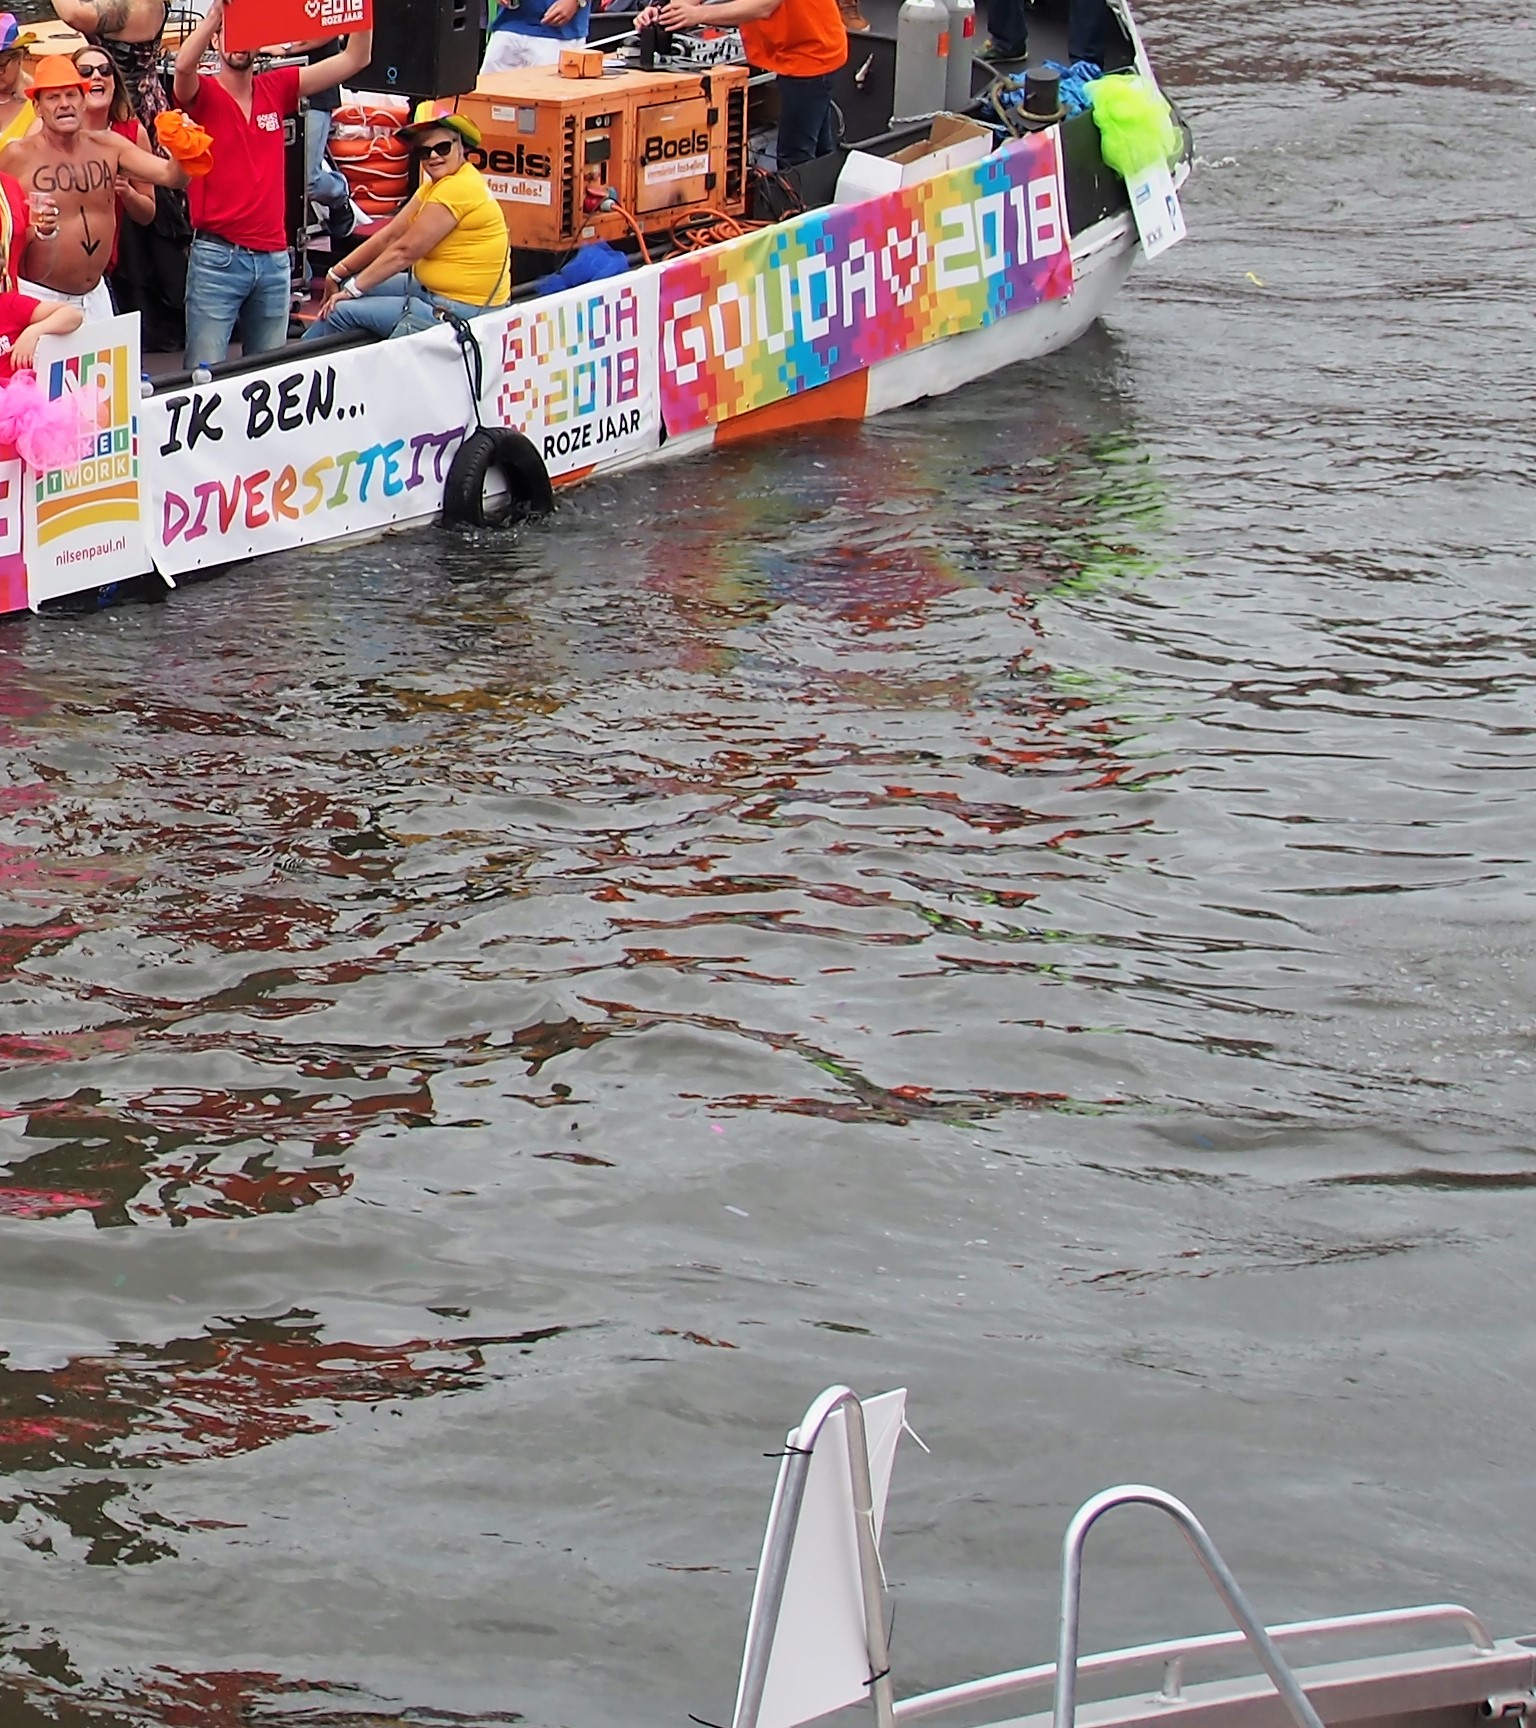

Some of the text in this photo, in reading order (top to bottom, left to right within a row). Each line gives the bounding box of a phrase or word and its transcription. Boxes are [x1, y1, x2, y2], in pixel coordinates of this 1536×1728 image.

[321, 11, 364, 27] ROZE JAAR
[465, 144, 552, 178] oels
[645, 129, 708, 161] Boels
[32, 159, 113, 193] GOUDA
[487, 178, 542, 198] fast alles!
[664, 173, 1062, 384] GOUDA 2018
[501, 287, 638, 373] GOUDA
[543, 345, 638, 426] 2018
[160, 365, 365, 456] IK BEN...
[543, 410, 641, 460] ROZE JAAR
[162, 424, 467, 547] DIVERSITEIT
[55, 535, 126, 566] nilsenpaul.nl
